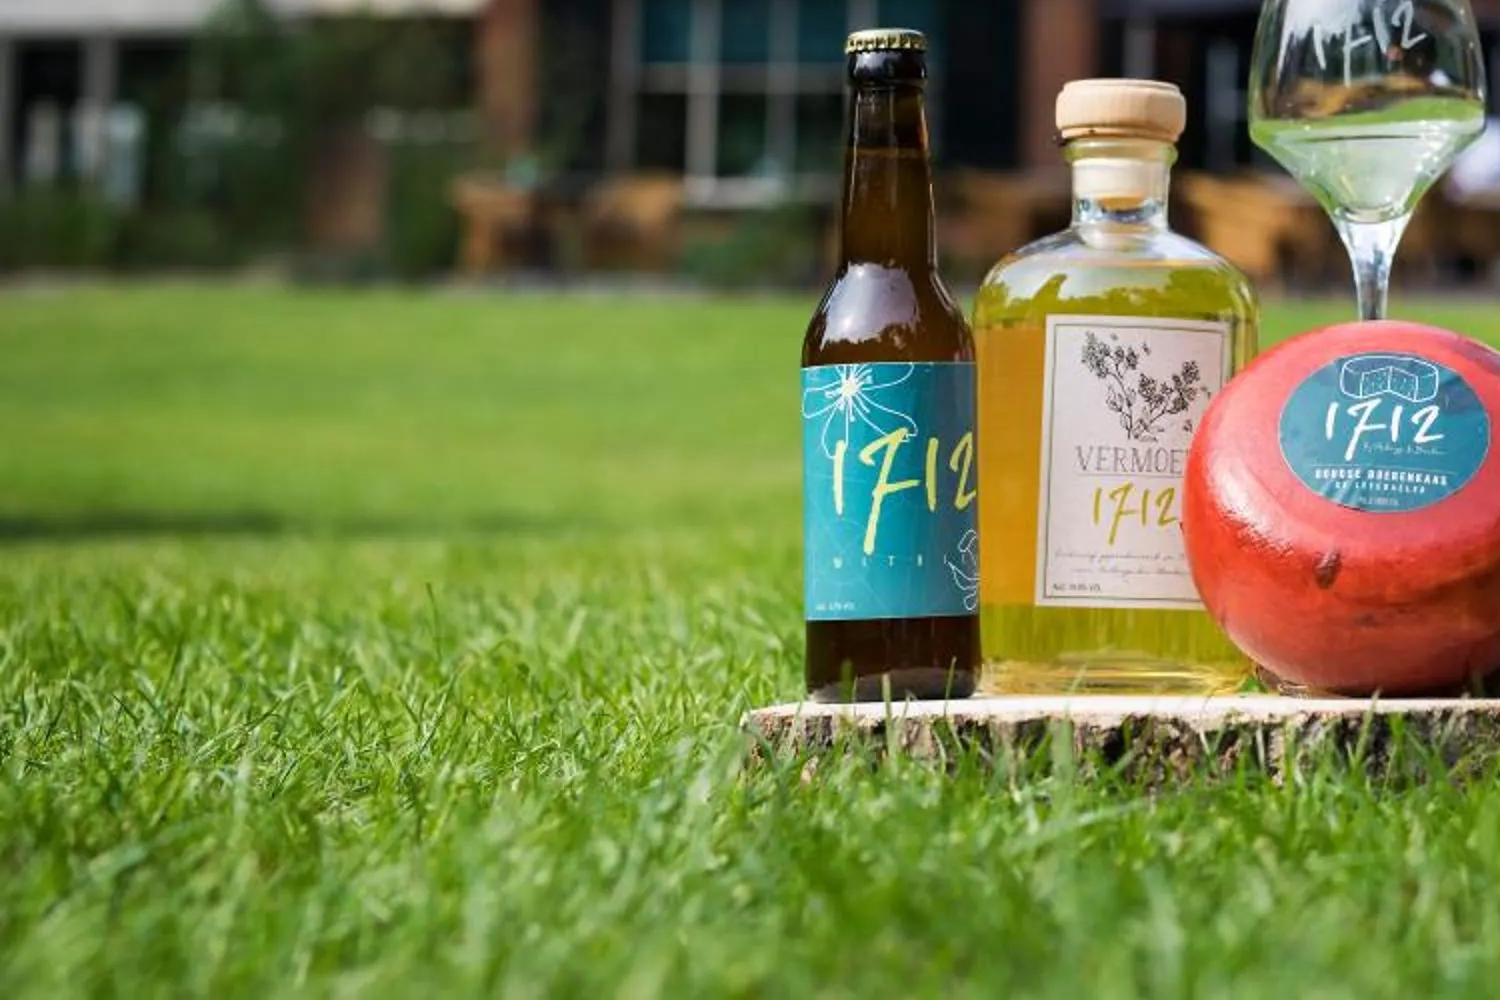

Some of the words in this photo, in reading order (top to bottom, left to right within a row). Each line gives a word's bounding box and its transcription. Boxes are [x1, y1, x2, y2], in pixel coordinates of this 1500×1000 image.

[1074, 446, 1188, 475] VERMOE
[1324, 398, 1445, 461] 1712
[833, 427, 976, 555] 1712
[1092, 482, 1178, 547] 1712
